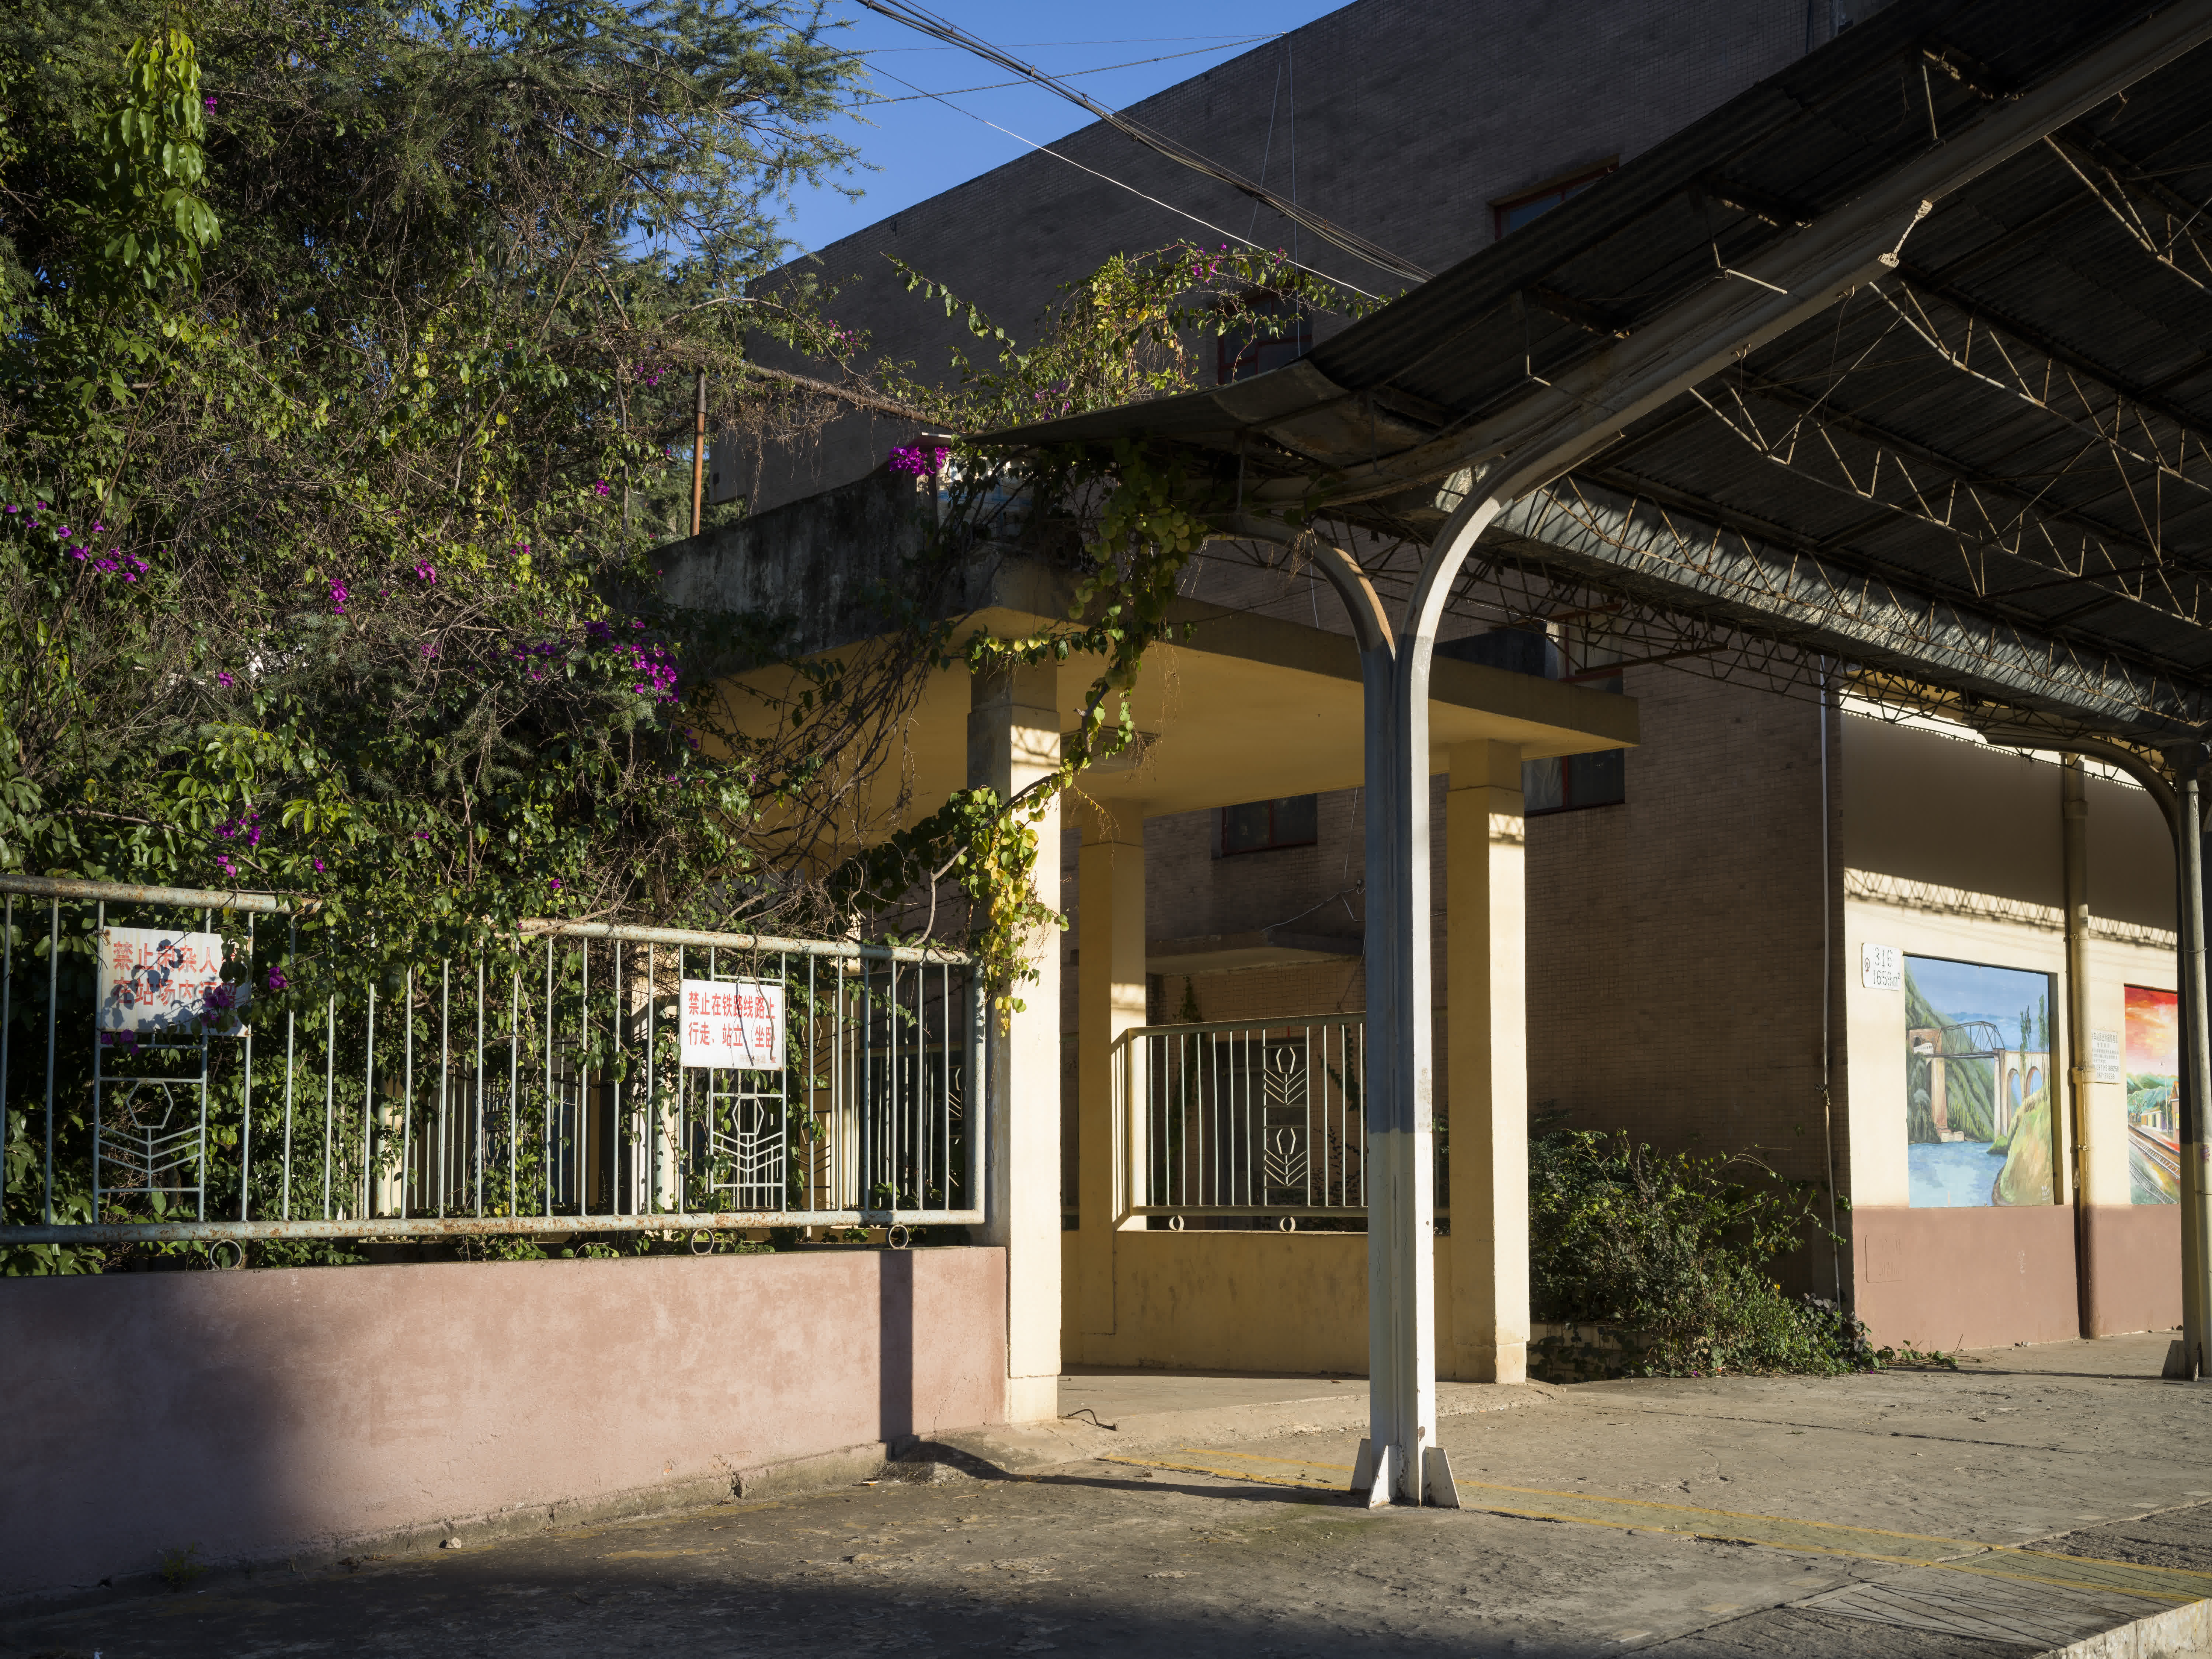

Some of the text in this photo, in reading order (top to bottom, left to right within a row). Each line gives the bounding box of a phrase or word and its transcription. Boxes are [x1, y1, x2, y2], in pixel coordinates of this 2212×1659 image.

[113, 941, 236, 974] 禁止闲杂人
[1875, 947, 1892, 967] 316
[688, 991, 775, 1019] 禁止在铁路线路上
